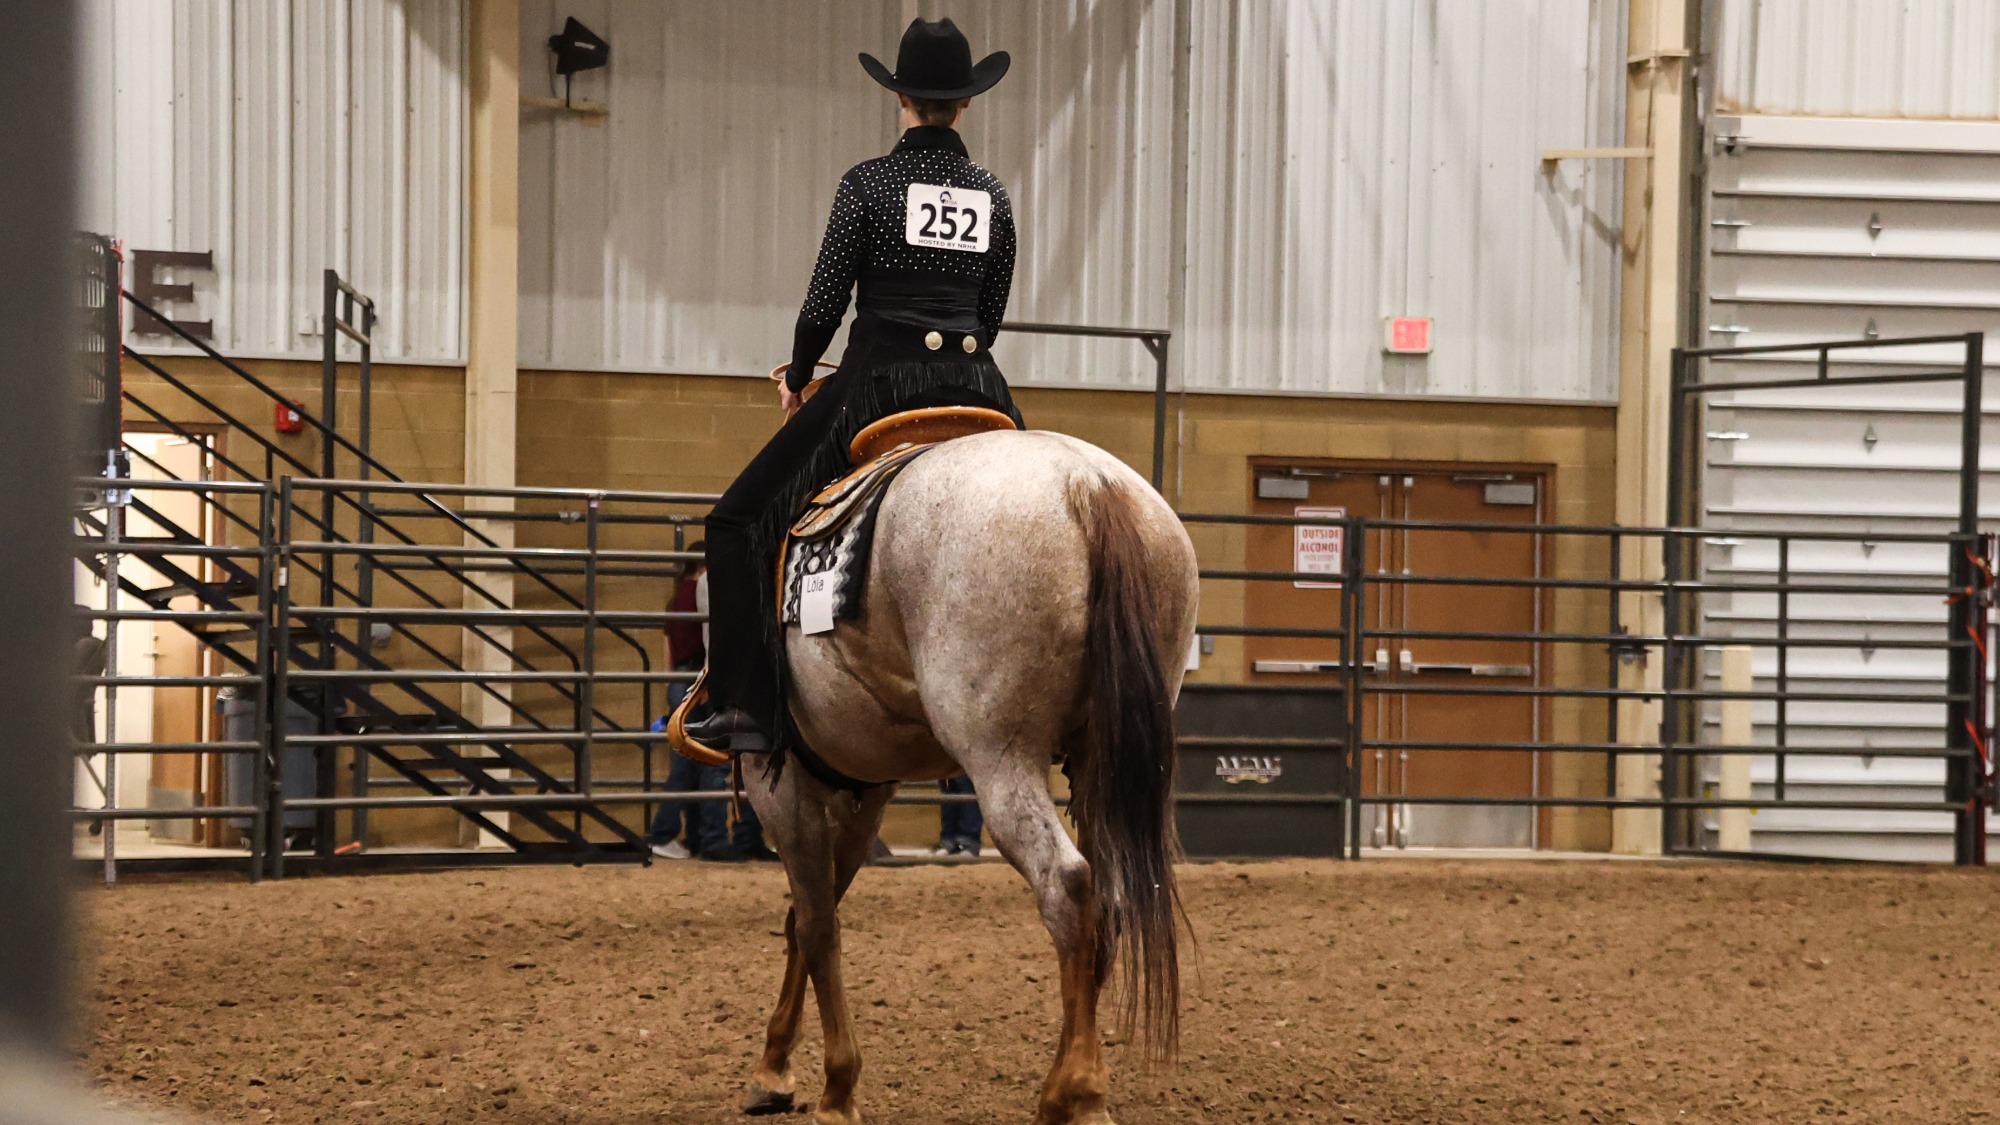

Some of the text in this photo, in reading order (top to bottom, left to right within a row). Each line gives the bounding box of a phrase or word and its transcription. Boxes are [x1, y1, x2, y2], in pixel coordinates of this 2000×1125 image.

[919, 203, 978, 243] 252
[918, 239, 946, 247] HOSTED
[131, 249, 212, 340] E
[1300, 543, 1339, 553] ALCOHOL
